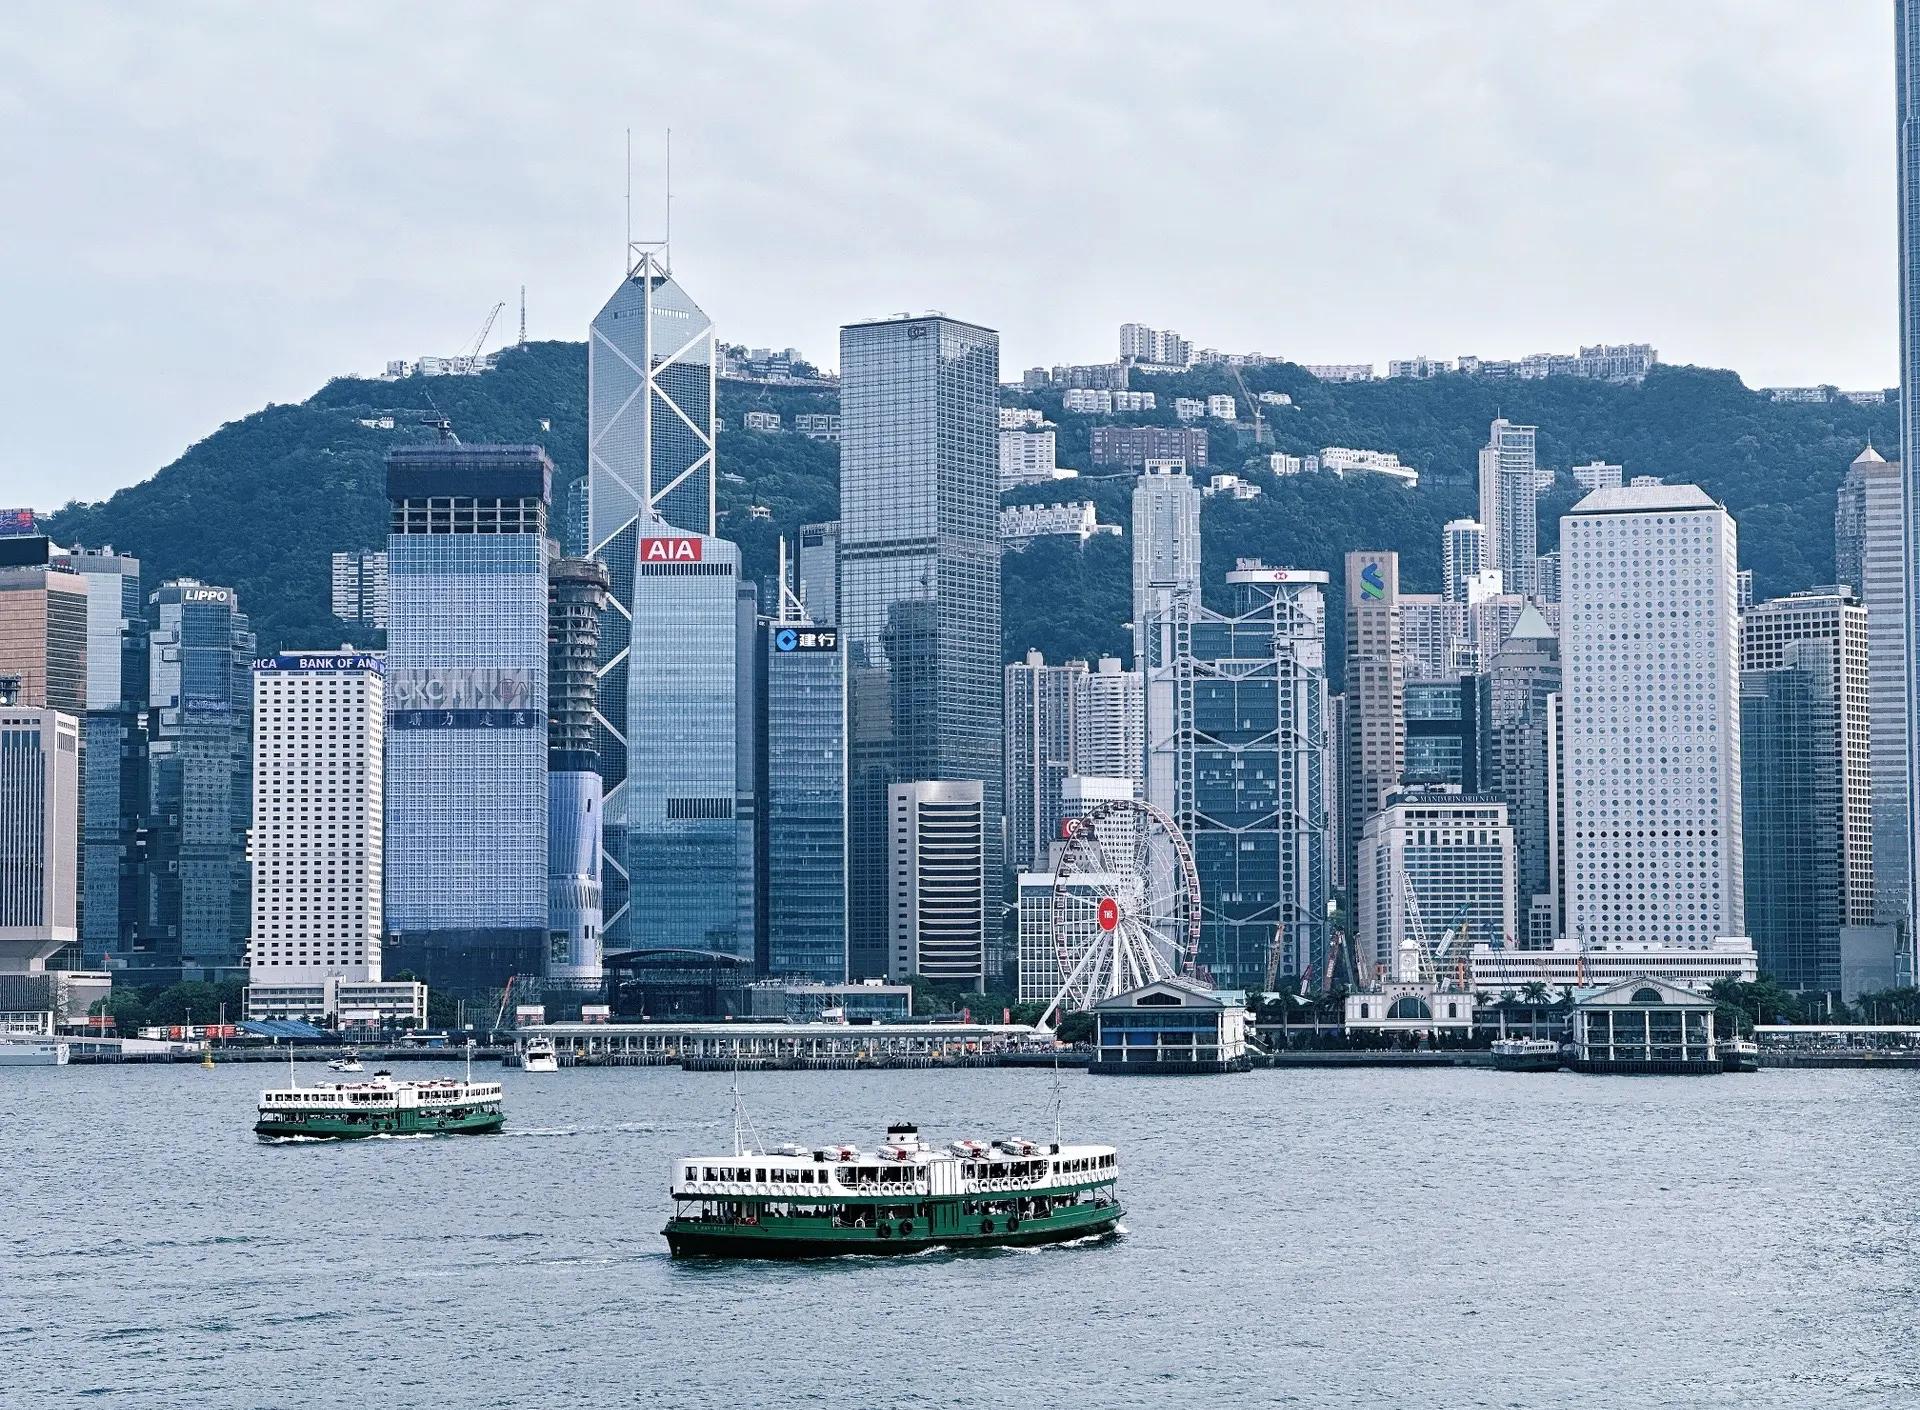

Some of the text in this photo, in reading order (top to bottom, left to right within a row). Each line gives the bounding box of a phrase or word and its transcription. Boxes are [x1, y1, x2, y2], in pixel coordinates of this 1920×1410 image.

[647, 541, 695, 560] AIA
[185, 590, 228, 602] LIPPO
[799, 633, 836, 647] 建行
[299, 658, 334, 669] BANK
[337, 658, 354, 669] OF
[1420, 795, 1461, 803] MANDARIN
